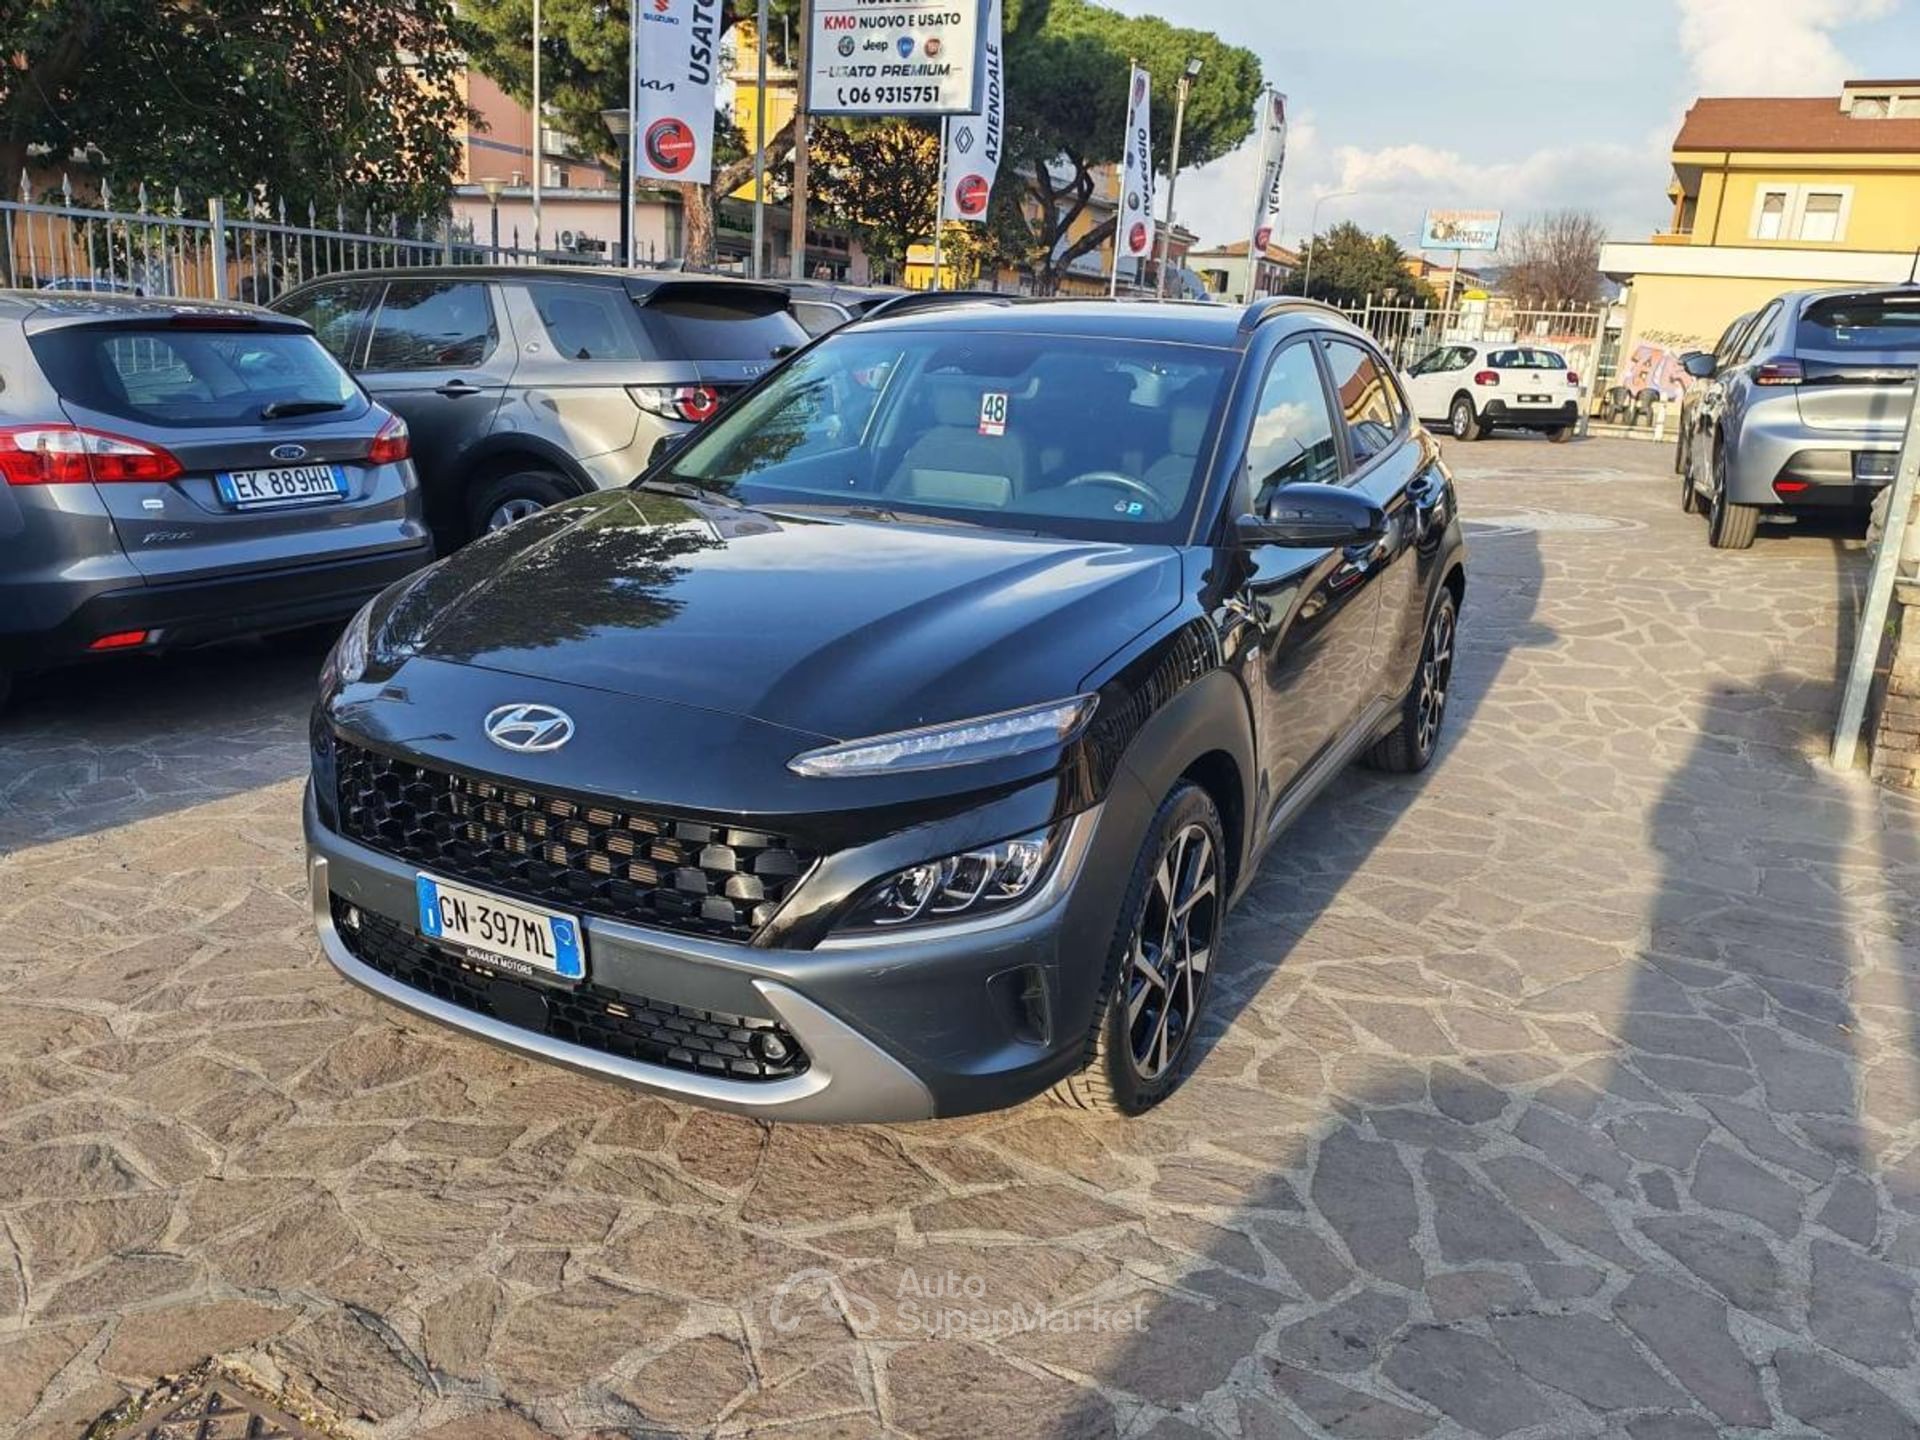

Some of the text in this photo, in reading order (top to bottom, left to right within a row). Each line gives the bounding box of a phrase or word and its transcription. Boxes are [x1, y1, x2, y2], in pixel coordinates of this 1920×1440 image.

[859, 14, 906, 29] NUOVO
[908, 14, 915, 27] E
[918, 12, 961, 27] USATO
[862, 39, 889, 53] Jeep
[880, 63, 950, 78] PREMIUM
[850, 86, 940, 104] 06 9315751
[986, 42, 999, 164] AZIENDALE
[983, 395, 1005, 422] 48
[233, 472, 265, 499] EK
[268, 465, 335, 496] 889HH
[438, 895, 469, 934] GN
[476, 906, 555, 960] 397ML
[500, 958, 533, 976] MOTORS
